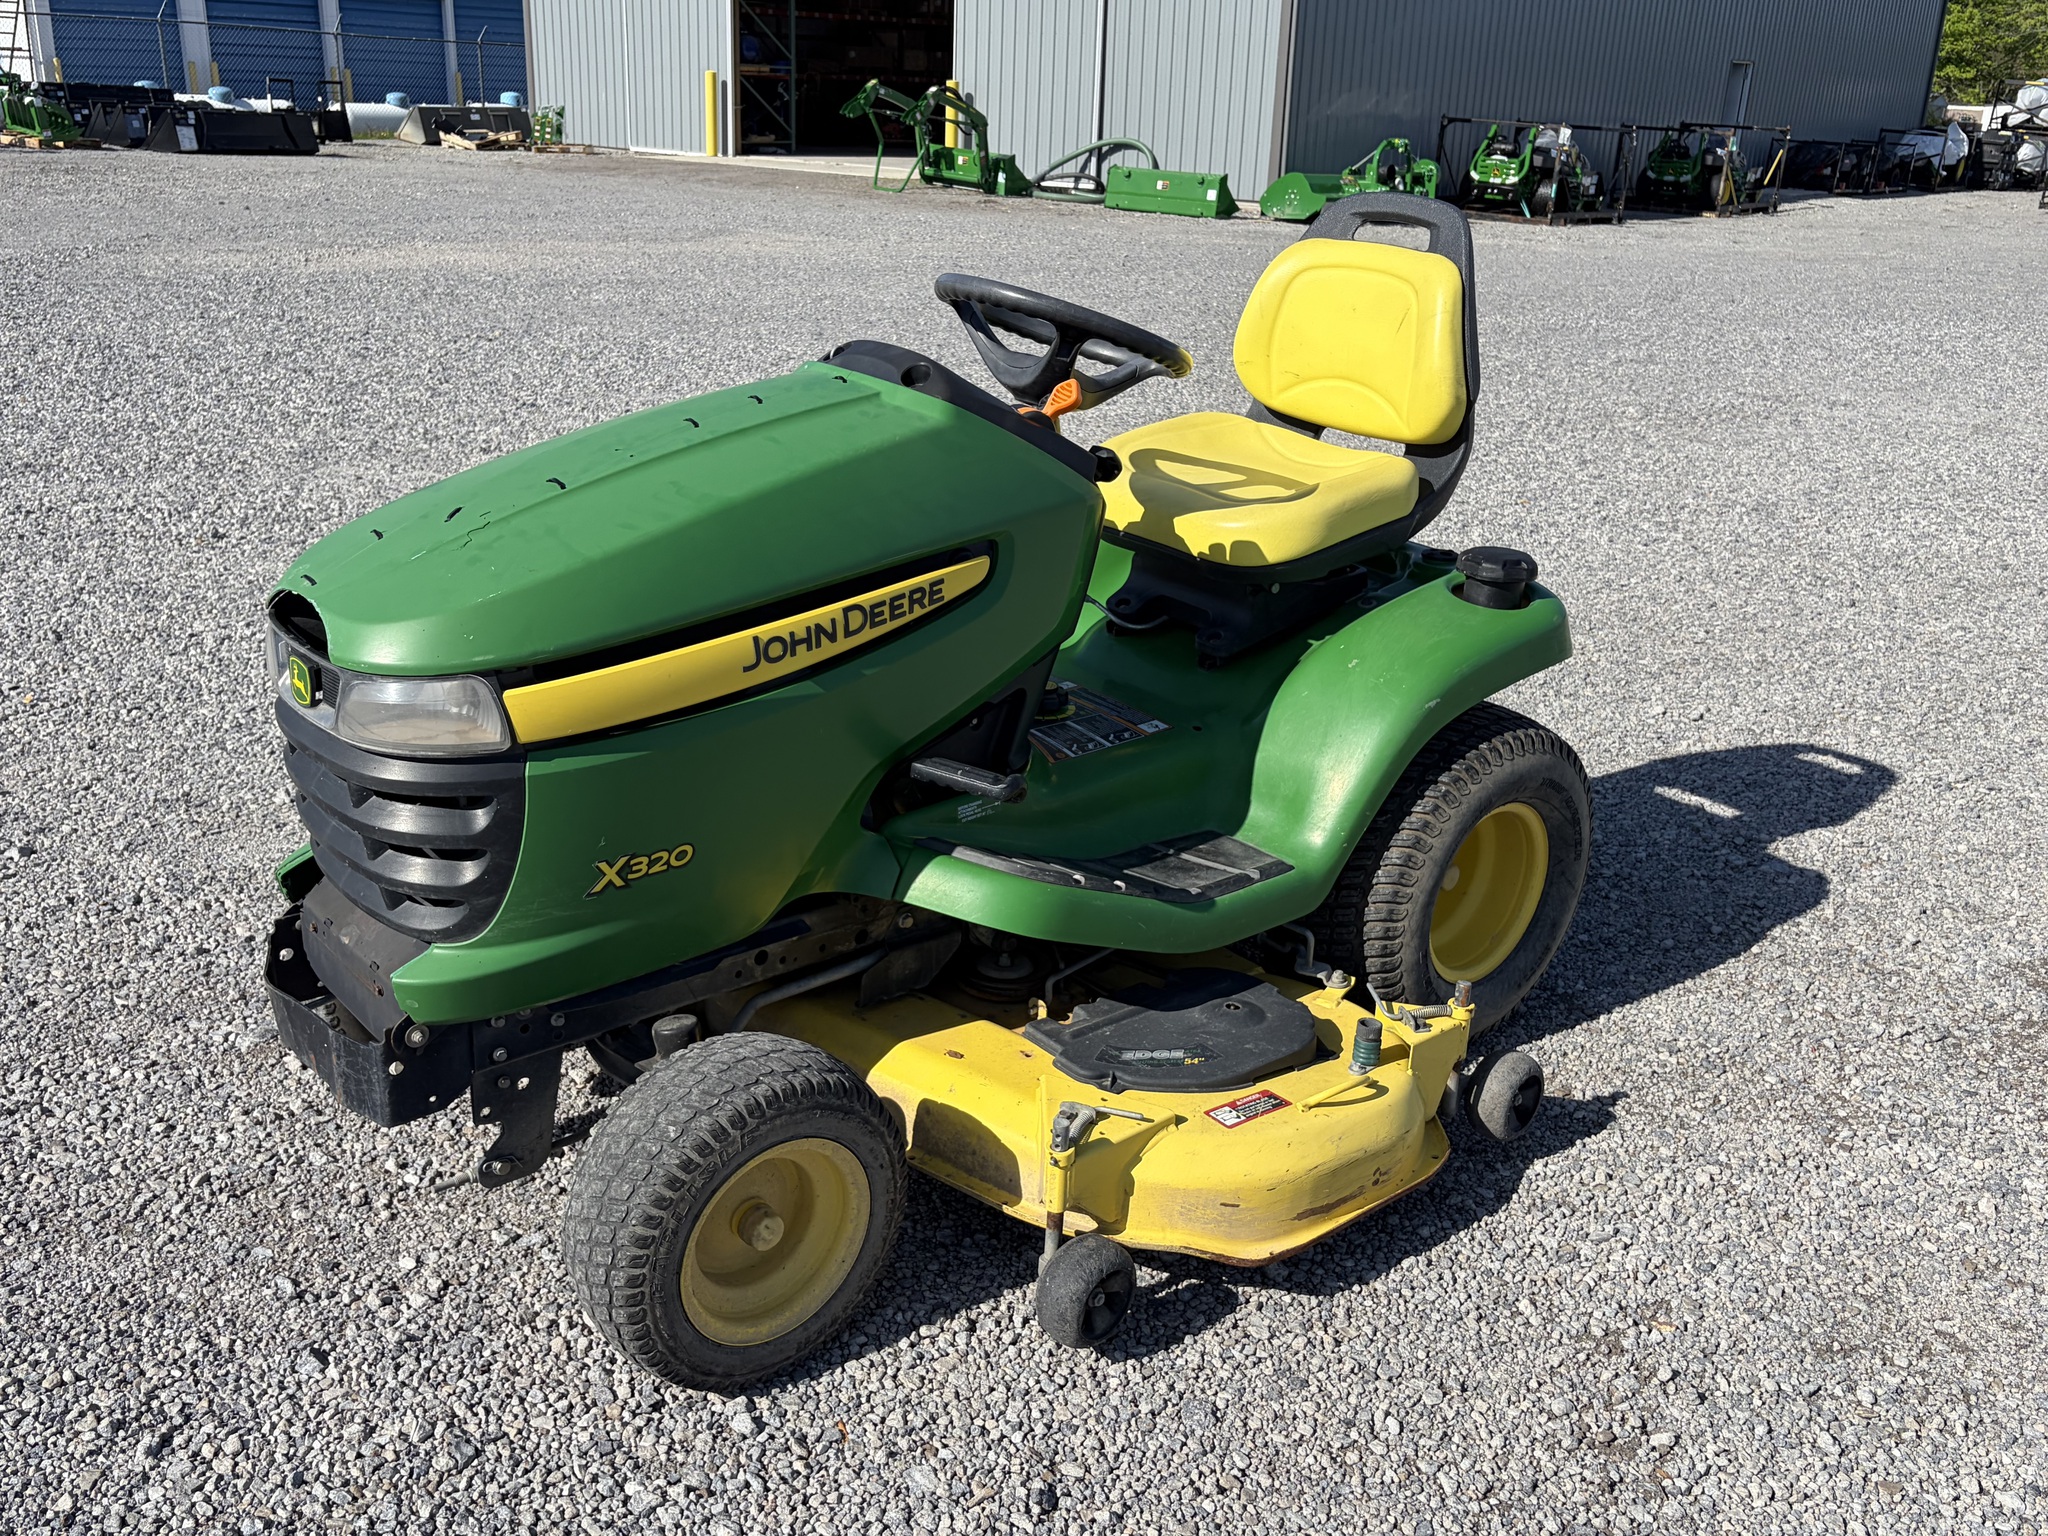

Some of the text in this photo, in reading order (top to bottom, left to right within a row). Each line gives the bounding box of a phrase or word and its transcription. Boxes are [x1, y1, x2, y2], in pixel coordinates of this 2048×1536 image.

[743, 577, 945, 673] JOHN DEERE
[587, 843, 695, 895] X320
[1120, 1048, 1185, 1060] EDGE
[1183, 1057, 1205, 1066] 54"
